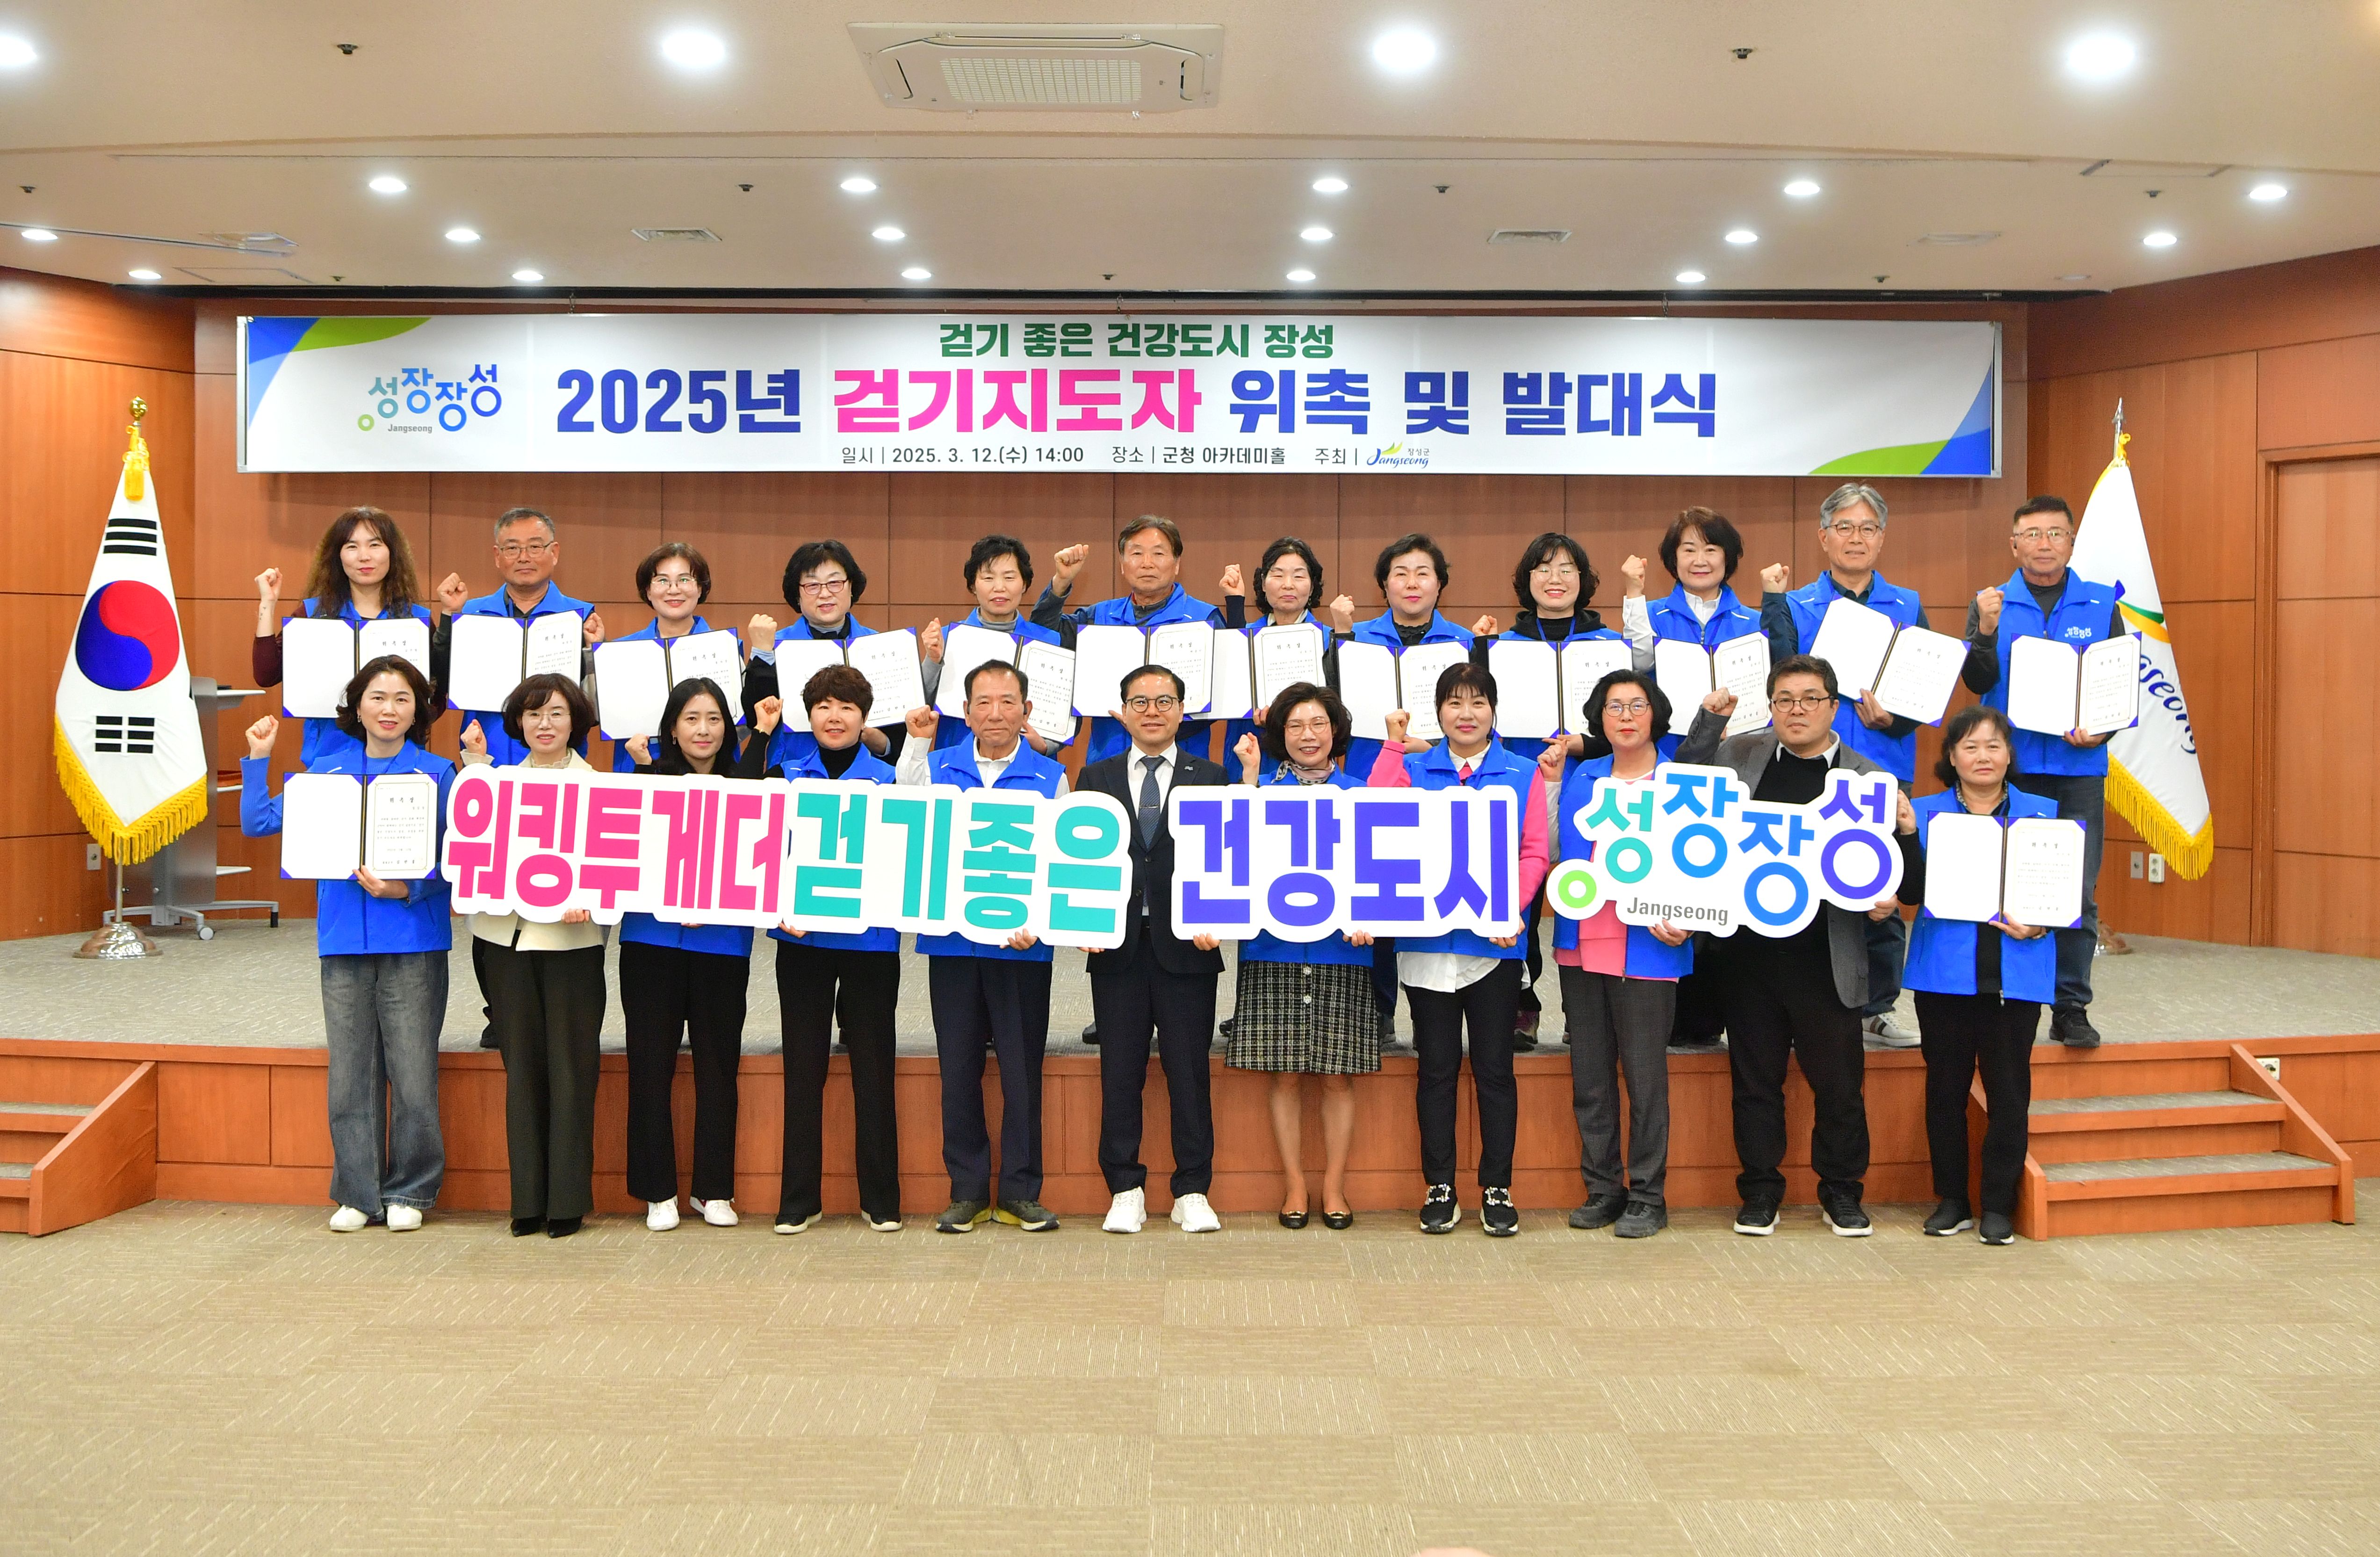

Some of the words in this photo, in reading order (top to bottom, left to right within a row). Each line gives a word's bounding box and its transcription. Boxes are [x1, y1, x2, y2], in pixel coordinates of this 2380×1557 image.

[940, 323, 1009, 357] 걷기
[1024, 323, 1093, 357] 좋은
[1108, 323, 1249, 357] 건강도시
[1264, 325, 1333, 358] 장성
[368, 364, 502, 432] 성장장성
[558, 369, 801, 434] 2025년
[834, 368, 1202, 433] 걷기지도자
[1229, 369, 1370, 435] 위촉
[1404, 370, 1470, 435] 및
[1503, 371, 1716, 438] 발대식
[388, 424, 433, 434] Jangseong
[842, 447, 873, 464] 일시
[893, 448, 941, 463] 2025.
[948, 448, 963, 463] 3.
[1036, 447, 1083, 462] 14:00
[1112, 446, 1144, 463] 장소
[1162, 446, 1194, 464] 군청
[1203, 447, 1285, 464] 아카데미홀
[1315, 448, 1346, 465] 주최
[1367, 448, 1429, 468] Jangseong
[447, 778, 786, 913] 워킹투게더
[793, 792, 1122, 933] 걷기좋은
[1179, 798, 1509, 927] 건강도시
[1585, 773, 1892, 926] 성장장성
[1627, 897, 1729, 926] Jangseong
